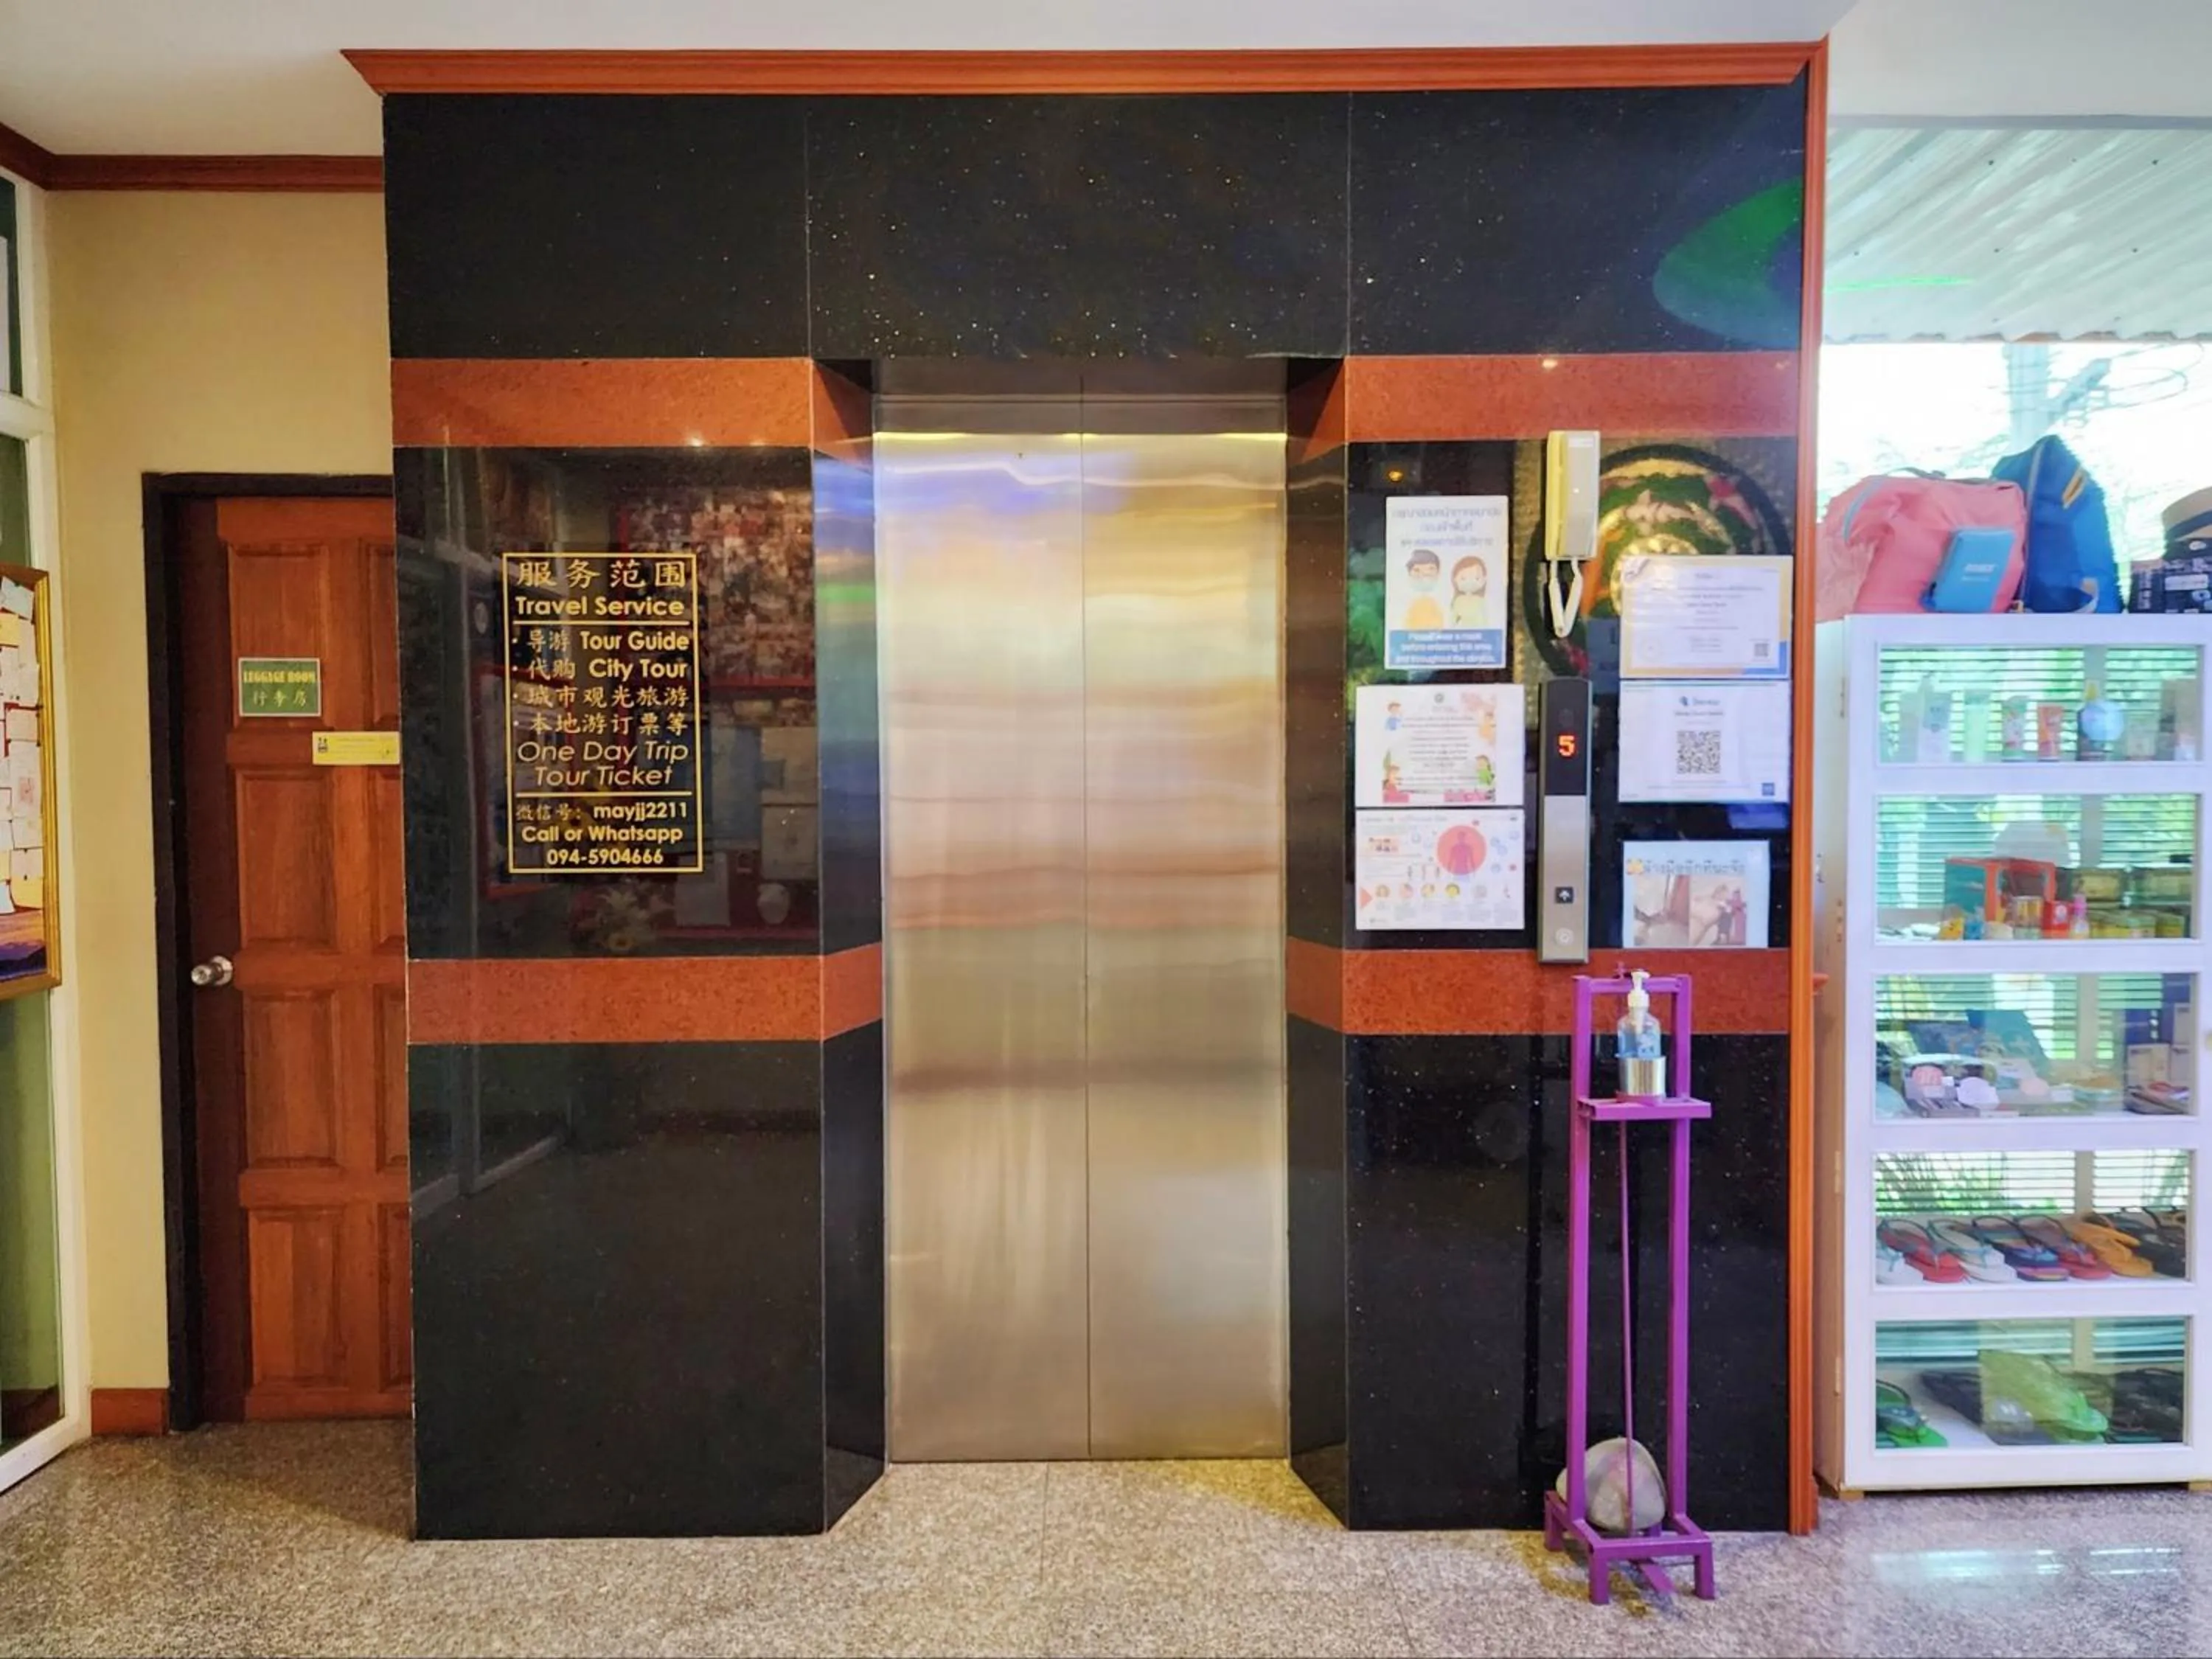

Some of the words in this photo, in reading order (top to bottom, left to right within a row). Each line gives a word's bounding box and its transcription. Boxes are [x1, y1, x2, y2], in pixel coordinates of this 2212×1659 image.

[517, 559, 686, 588] 服务范围
[515, 596, 588, 616] Travel
[595, 596, 685, 616] Service
[527, 629, 571, 653] 导游
[580, 630, 622, 650] Tour
[627, 630, 690, 650] Guide
[529, 658, 577, 681] 代购
[588, 658, 634, 682] City
[639, 658, 688, 678] Tour
[527, 684, 689, 709] 城市观光旅游
[529, 712, 689, 737] 本地游订票等
[518, 741, 576, 762] One
[582, 741, 638, 765] Day
[644, 740, 689, 765] Trip
[1559, 735, 1575, 757] 5
[535, 766, 591, 786] Tour
[596, 765, 673, 786] Ticket
[593, 801, 687, 822] mayjj2211
[521, 826, 560, 843] Call
[564, 828, 582, 842] or
[588, 825, 684, 844] Whatsapp
[546, 848, 664, 866] 094-5904666
